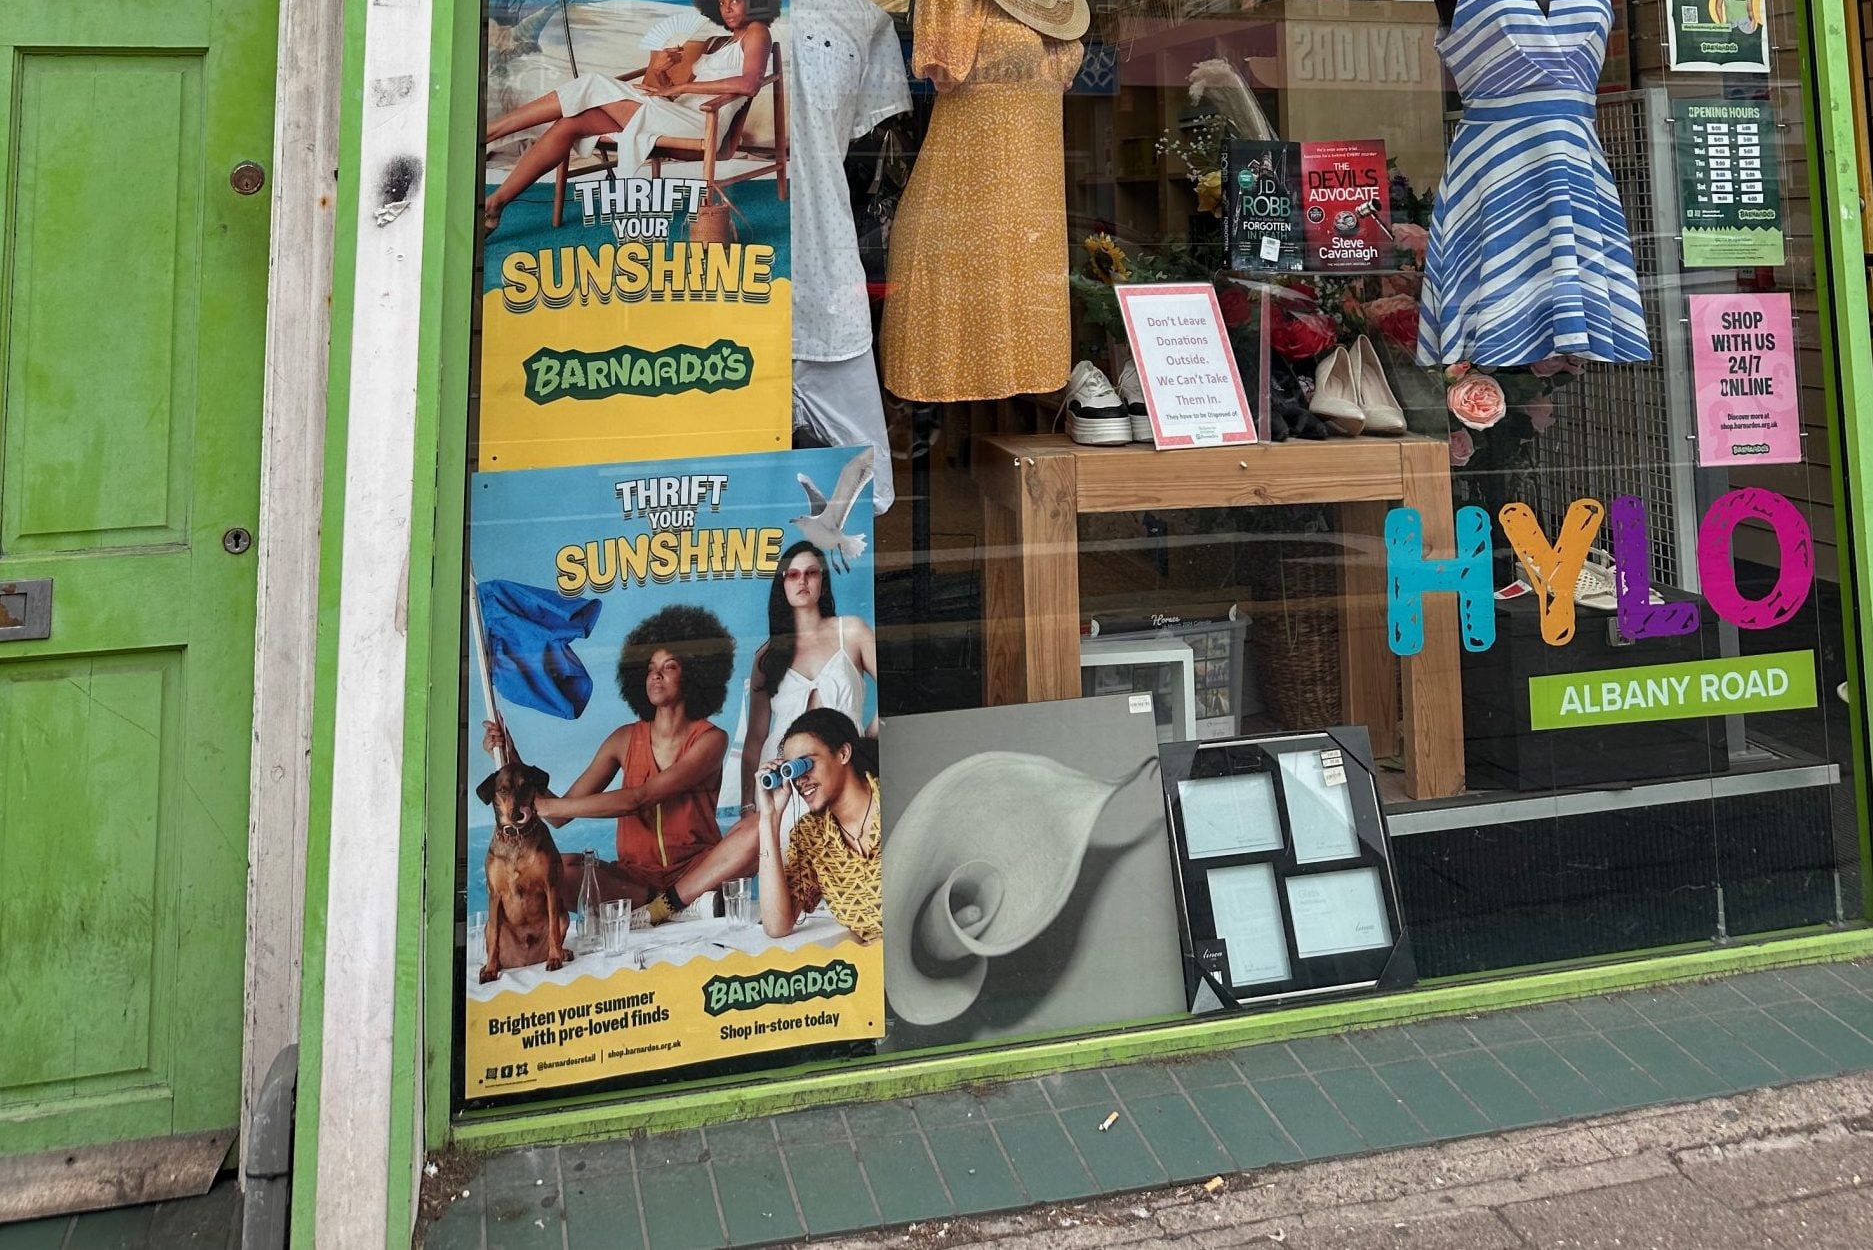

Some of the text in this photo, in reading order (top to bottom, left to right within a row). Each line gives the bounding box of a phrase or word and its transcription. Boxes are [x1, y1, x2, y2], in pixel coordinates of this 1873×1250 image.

[1688, 107, 1760, 118] OPENING HOURS
[1333, 162, 1351, 171] THE
[1257, 179, 1277, 196] J.D.
[1308, 168, 1379, 190] DEVIL'S
[573, 176, 709, 221] THRIFT
[1309, 187, 1381, 202] ADVOCATE
[1242, 195, 1291, 217] ROBB
[614, 217, 669, 239] YOUR
[1242, 221, 1291, 232] FORGOTTEN
[1247, 231, 1257, 240] IN
[1332, 237, 1364, 249] Steve
[1319, 246, 1378, 261] Cavanagh
[501, 241, 775, 310] SUNSHINE
[1147, 316, 1207, 327] Don't Leave
[1721, 311, 1763, 330] SHOP
[1156, 336, 1208, 347] Donations
[1712, 333, 1776, 352] WITH US
[1166, 355, 1209, 366] Outside.
[1728, 355, 1762, 377] 24/7
[532, 346, 747, 397] BARNARDO'S
[1156, 373, 1228, 386] We Can't Take
[1720, 377, 1773, 397] ONLINE
[1175, 394, 1221, 406] Them In.
[615, 474, 729, 514] THRIFT
[648, 510, 696, 528] YOUR
[555, 527, 785, 593] SUNSHINE
[1384, 486, 1816, 656] HYLO
[1559, 667, 1790, 717] ALBANY ROAD
[708, 963, 854, 1010] BARNARDO'S
[488, 990, 656, 1037] Brighten your summer
[521, 1005, 670, 1050] with pre-loved finds
[719, 1011, 841, 1041] Shop in-store today
[537, 1039, 682, 1072] @barnardosretail shop.barnardos.org.uk
